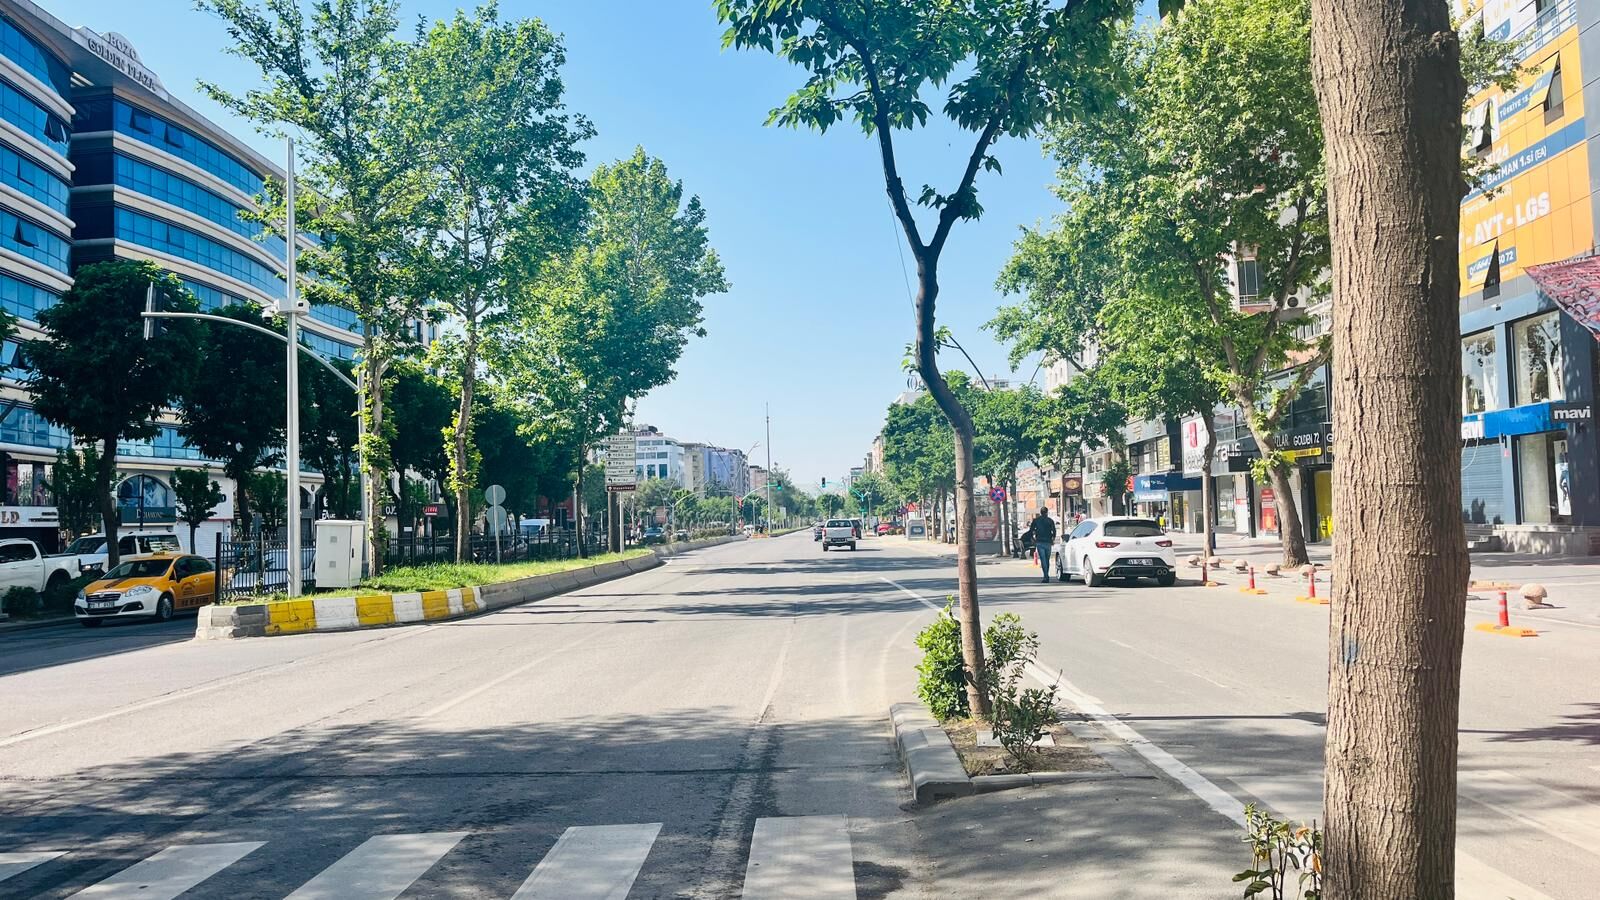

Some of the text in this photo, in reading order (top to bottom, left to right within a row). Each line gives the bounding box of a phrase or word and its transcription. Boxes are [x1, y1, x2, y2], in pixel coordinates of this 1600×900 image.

[87, 38, 157, 92] GOLDEN PLAZA
[1487, 160, 1518, 185] BATMAN
[1474, 212, 1504, 246] AYT
[1515, 191, 1551, 227] LGS
[1553, 406, 1591, 420] mavi
